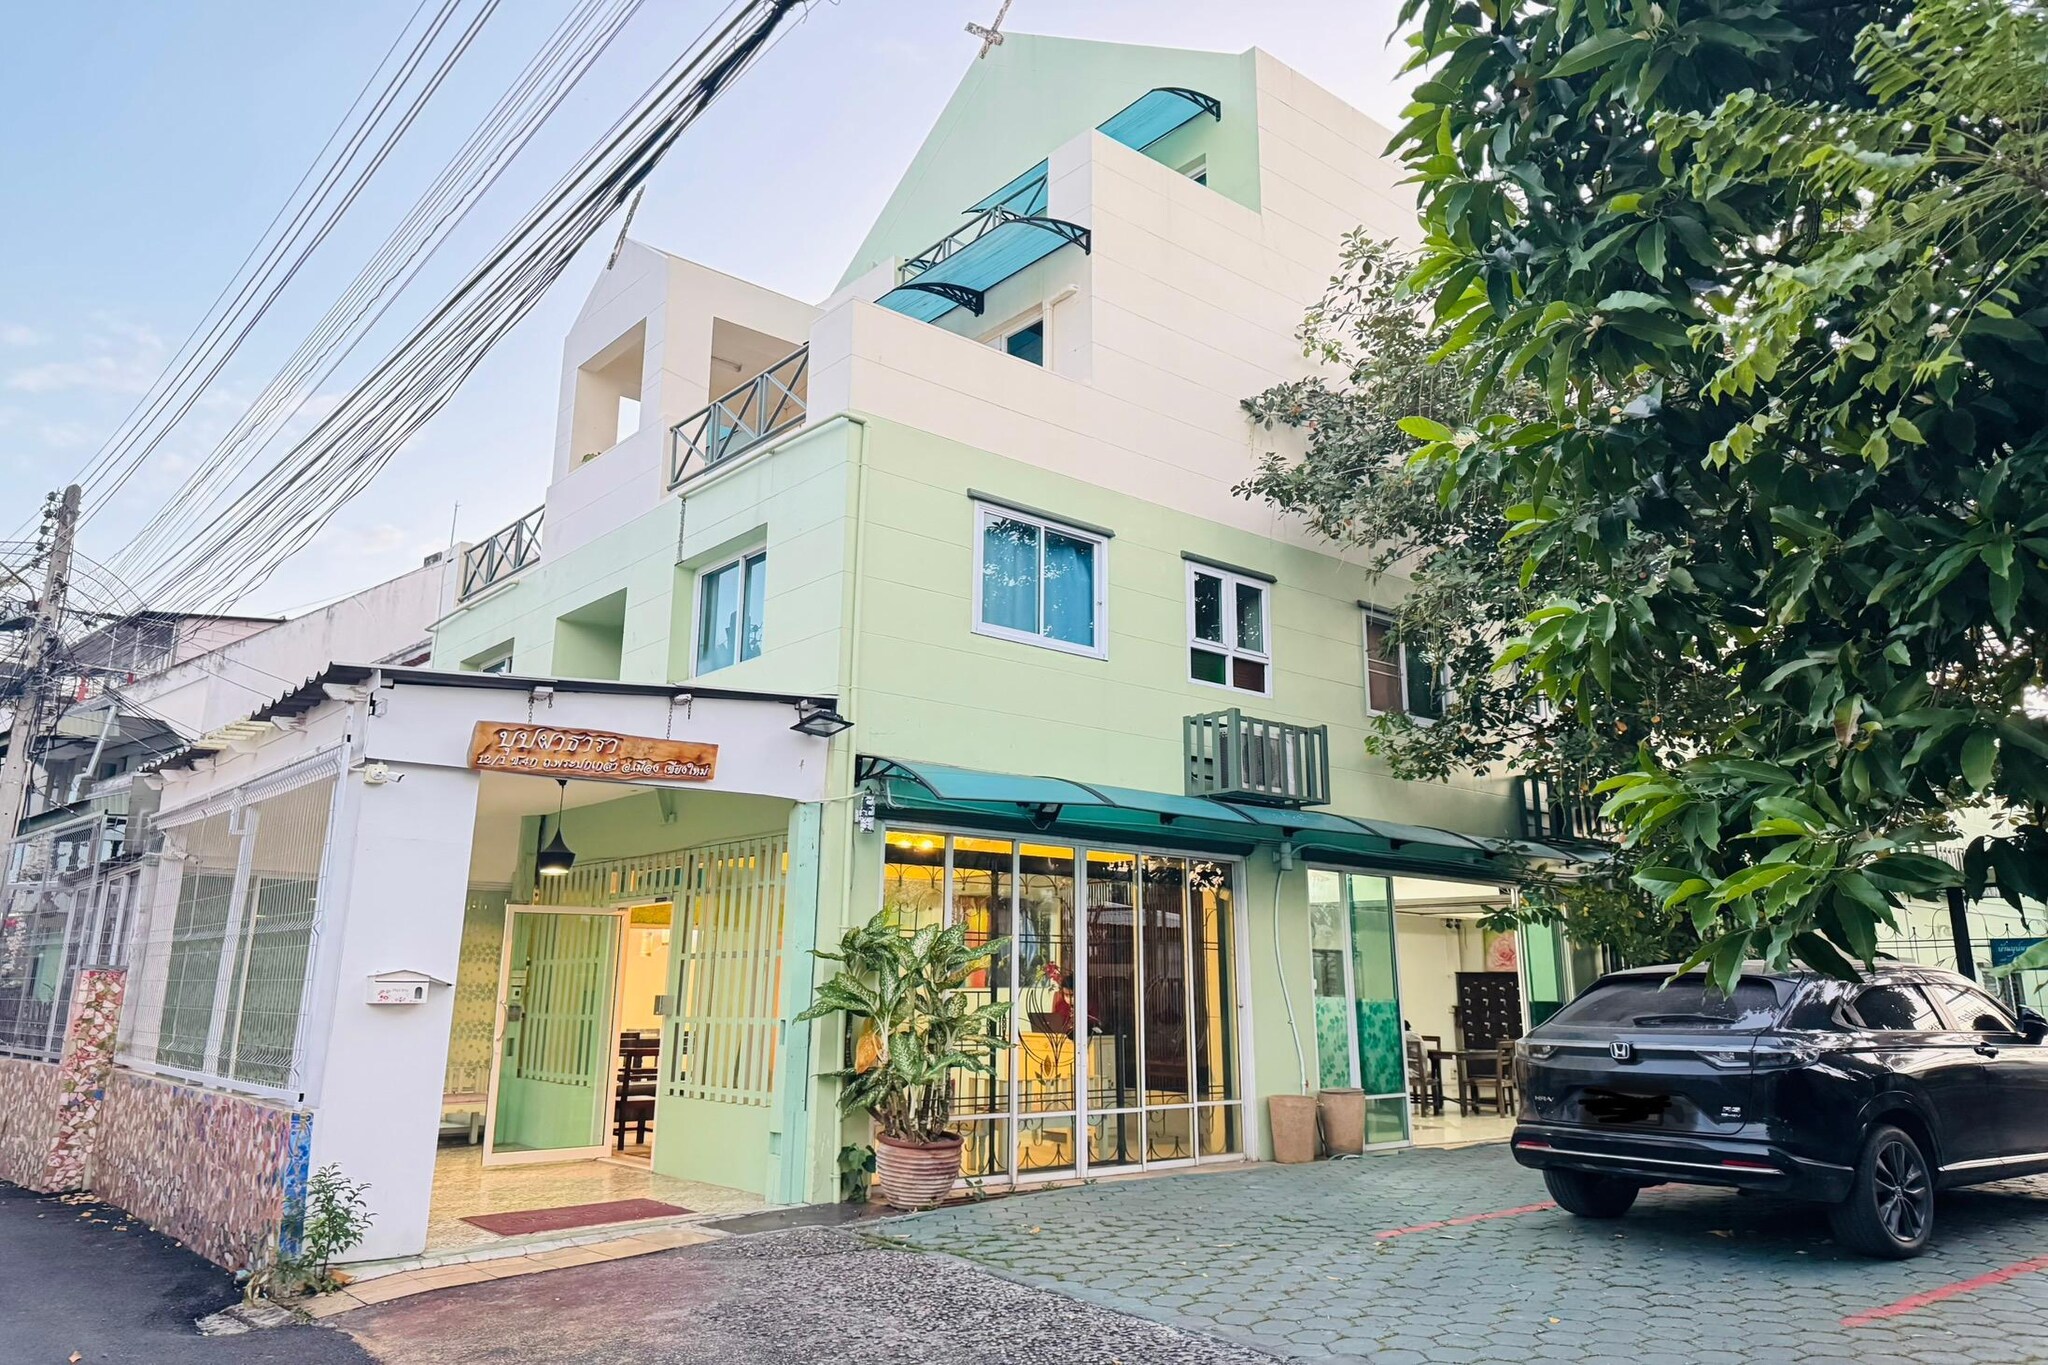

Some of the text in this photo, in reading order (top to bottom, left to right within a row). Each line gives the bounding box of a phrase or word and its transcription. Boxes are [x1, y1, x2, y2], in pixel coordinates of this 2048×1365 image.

[476, 754, 505, 766] 12/1
[664, 760, 711, 777] เชียงใหม่
